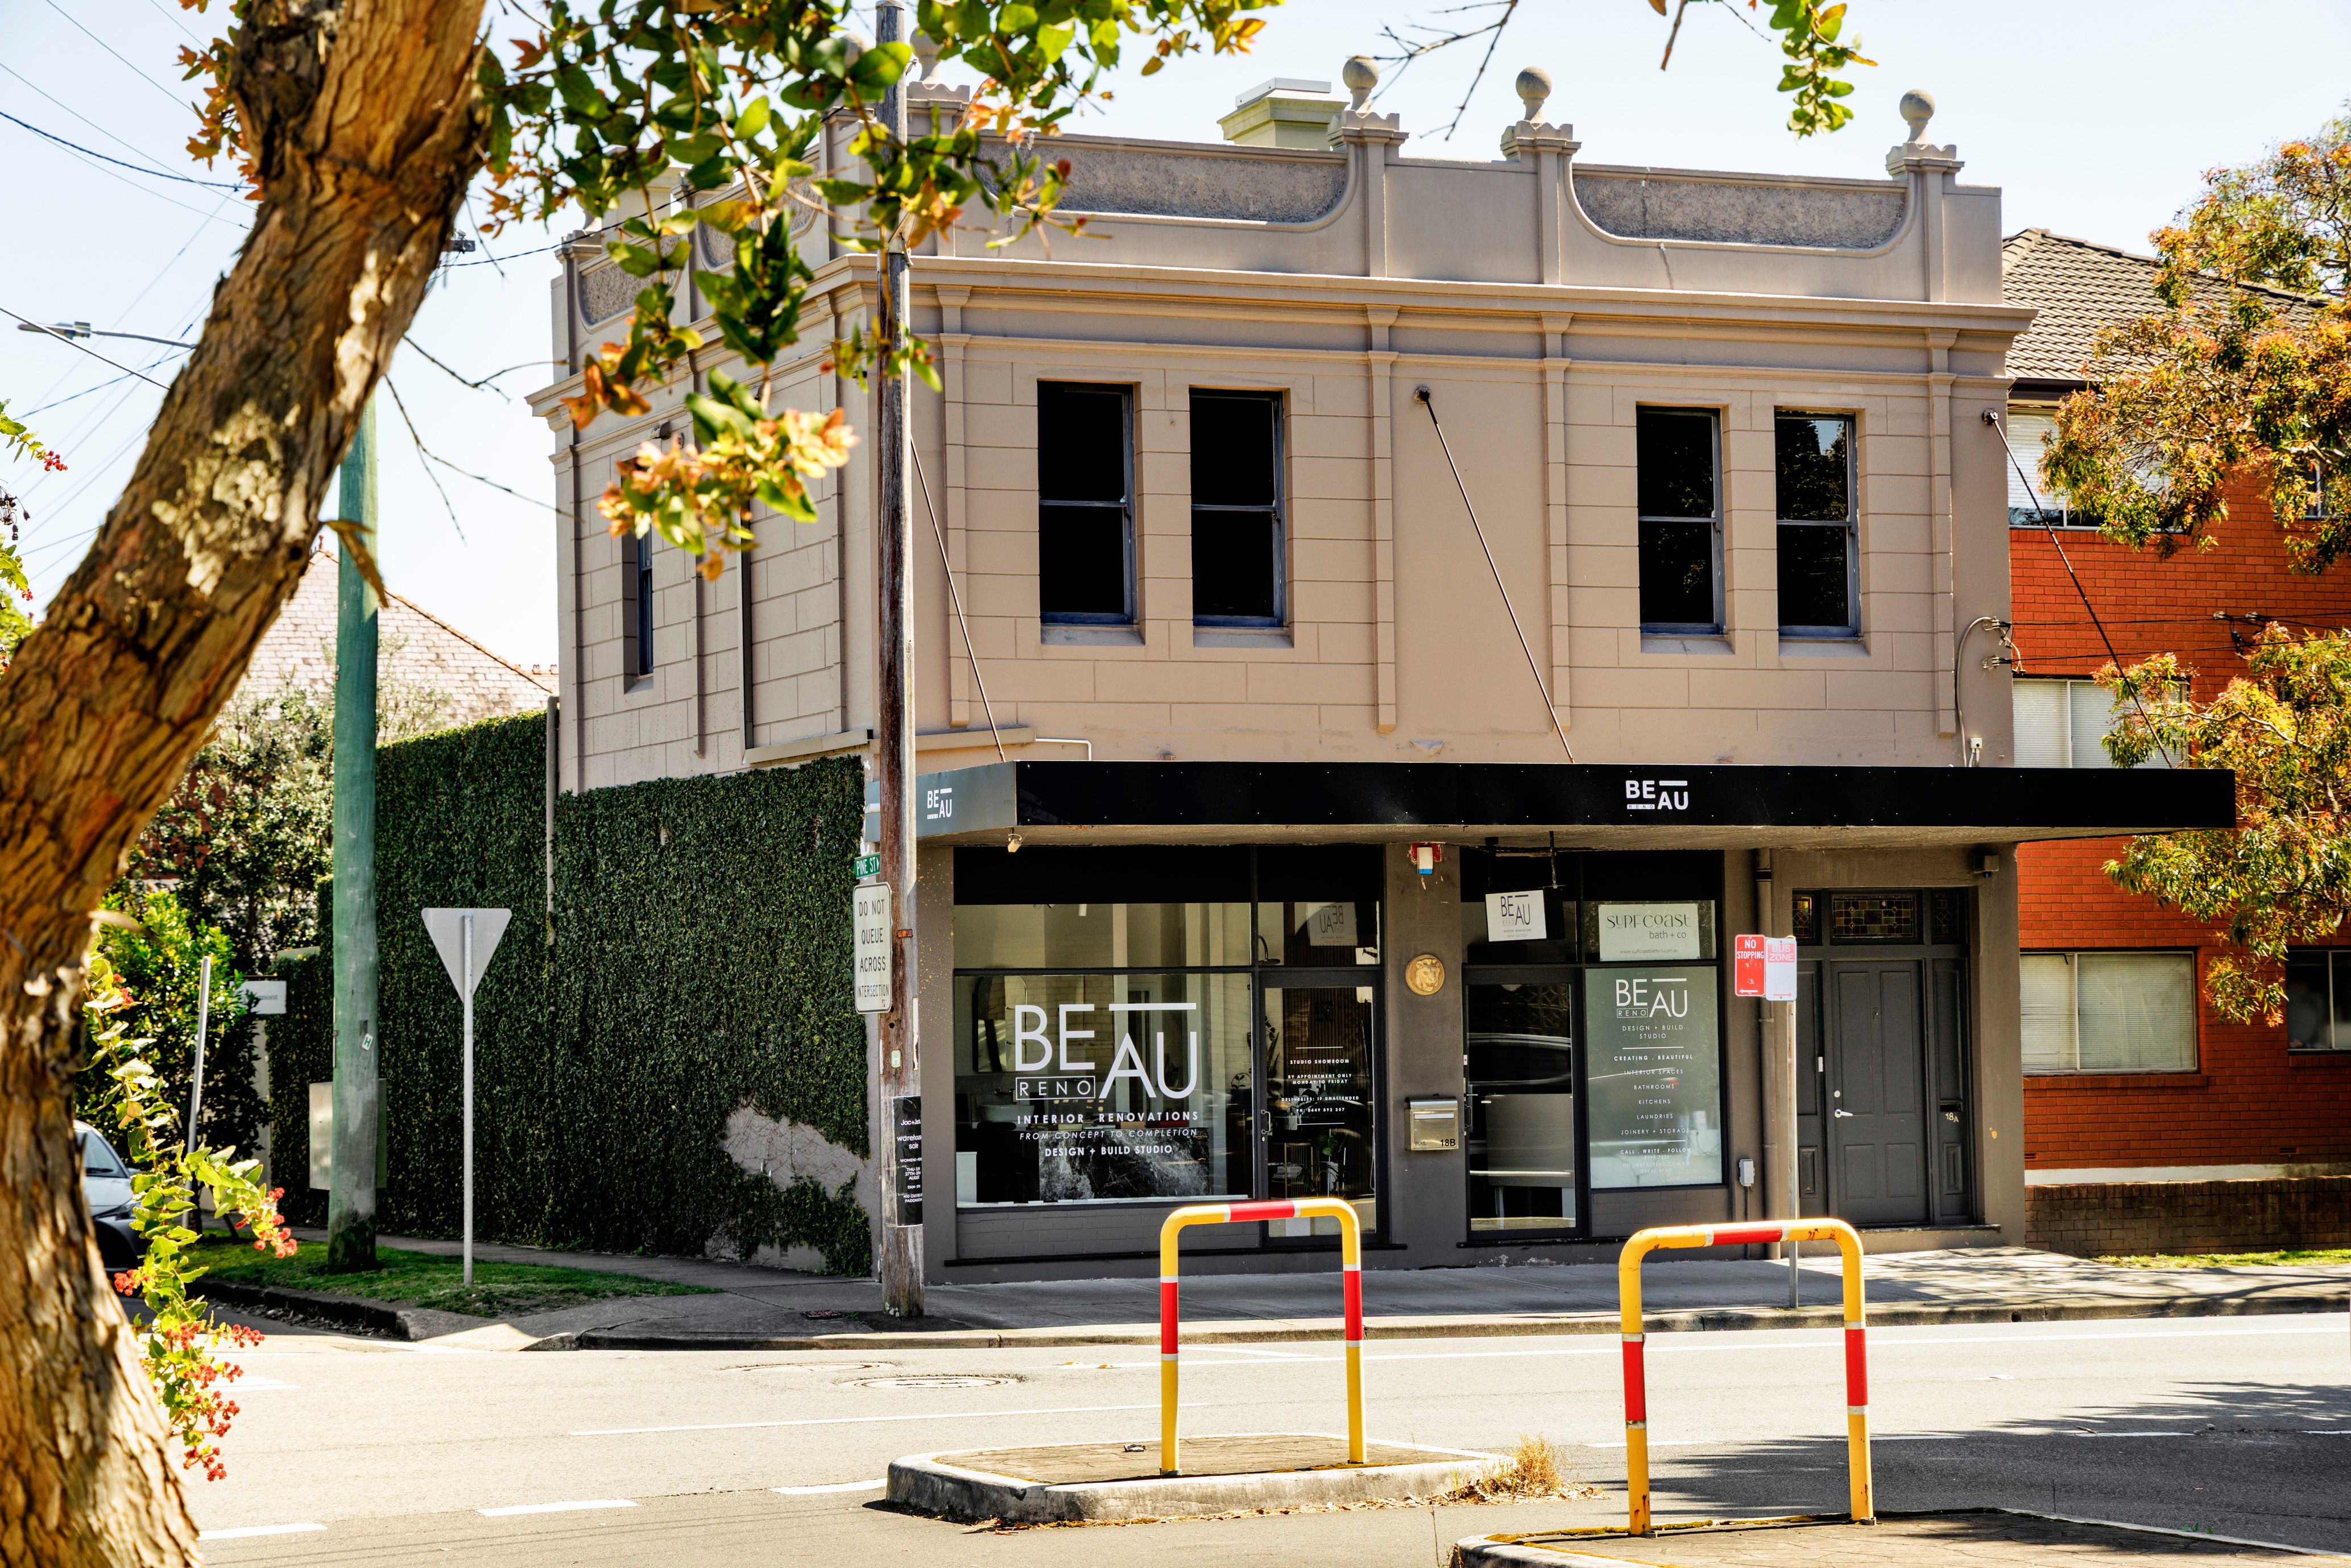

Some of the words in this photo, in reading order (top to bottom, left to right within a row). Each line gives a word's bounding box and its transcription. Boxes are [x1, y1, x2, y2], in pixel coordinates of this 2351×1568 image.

[856, 859, 868, 876] PINE
[870, 857, 876, 873] ST
[859, 901, 868, 916] DO
[872, 899, 884, 915] NOT
[862, 928, 883, 945] QUEUE
[1649, 930, 1668, 939] bath
[1744, 940, 1757, 949] NO
[1772, 944, 1791, 953] BUS
[1737, 951, 1764, 959] STOPPING
[860, 956, 886, 973] ACROSS
[857, 984, 889, 998] INTERSECTION
[364, 1037, 371, 1047] H
[1019, 1080, 1091, 1097] RENO
[1017, 1114, 1084, 1124] INTERIOR
[1099, 1111, 1198, 1123] RENOVATIONS
[1946, 1112, 1959, 1123] 18A
[1055, 1131, 1105, 1139] CONCEPT
[1129, 1129, 1197, 1137] COMPLETION
[1045, 1147, 1085, 1157] DESIGN
[1101, 1147, 1130, 1155] BUILD
[1135, 1145, 1173, 1154] STUDIO
